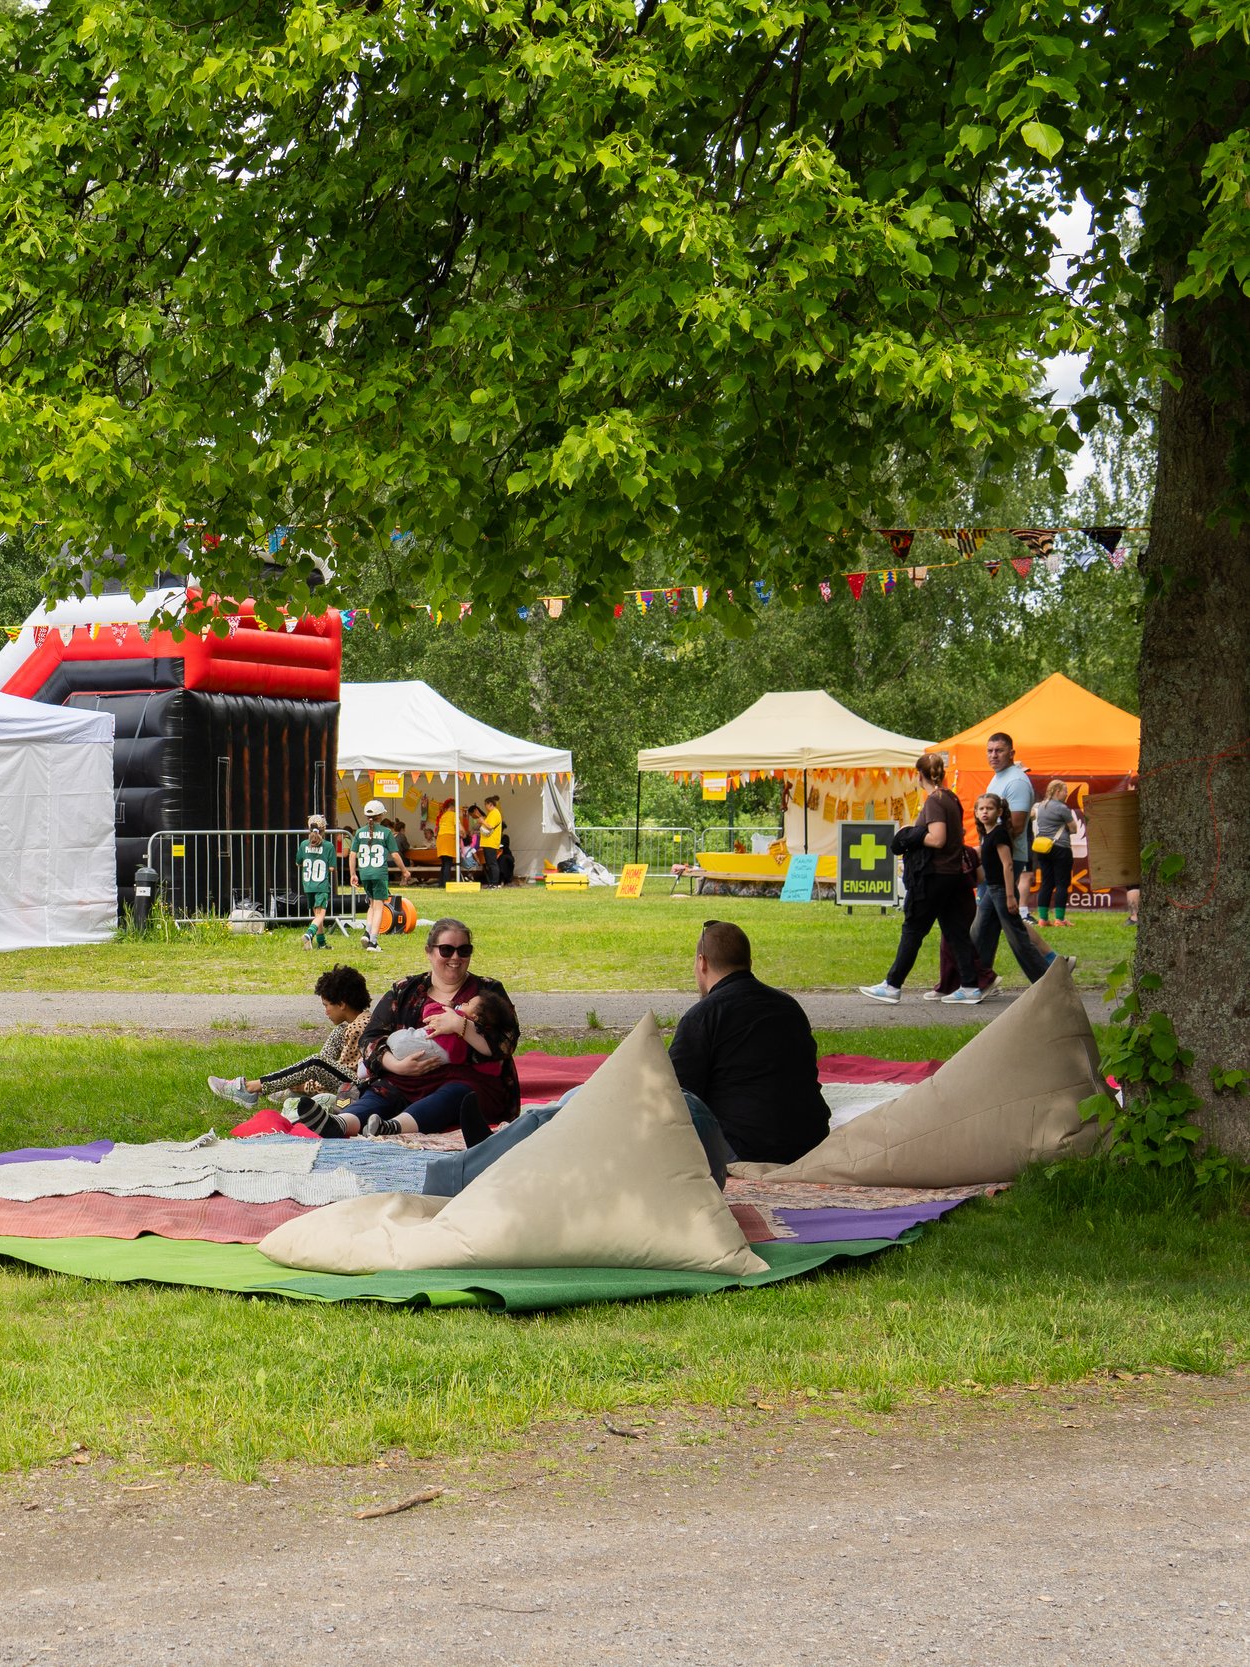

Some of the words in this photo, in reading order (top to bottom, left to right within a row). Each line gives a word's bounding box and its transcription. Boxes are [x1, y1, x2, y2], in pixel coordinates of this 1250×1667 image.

[358, 844, 384, 868] 33
[303, 859, 326, 882] 30
[624, 869, 643, 879] HOME
[620, 885, 638, 895] HOME
[843, 881, 891, 893] ENSIAPU
[1066, 892, 1111, 907] eam
